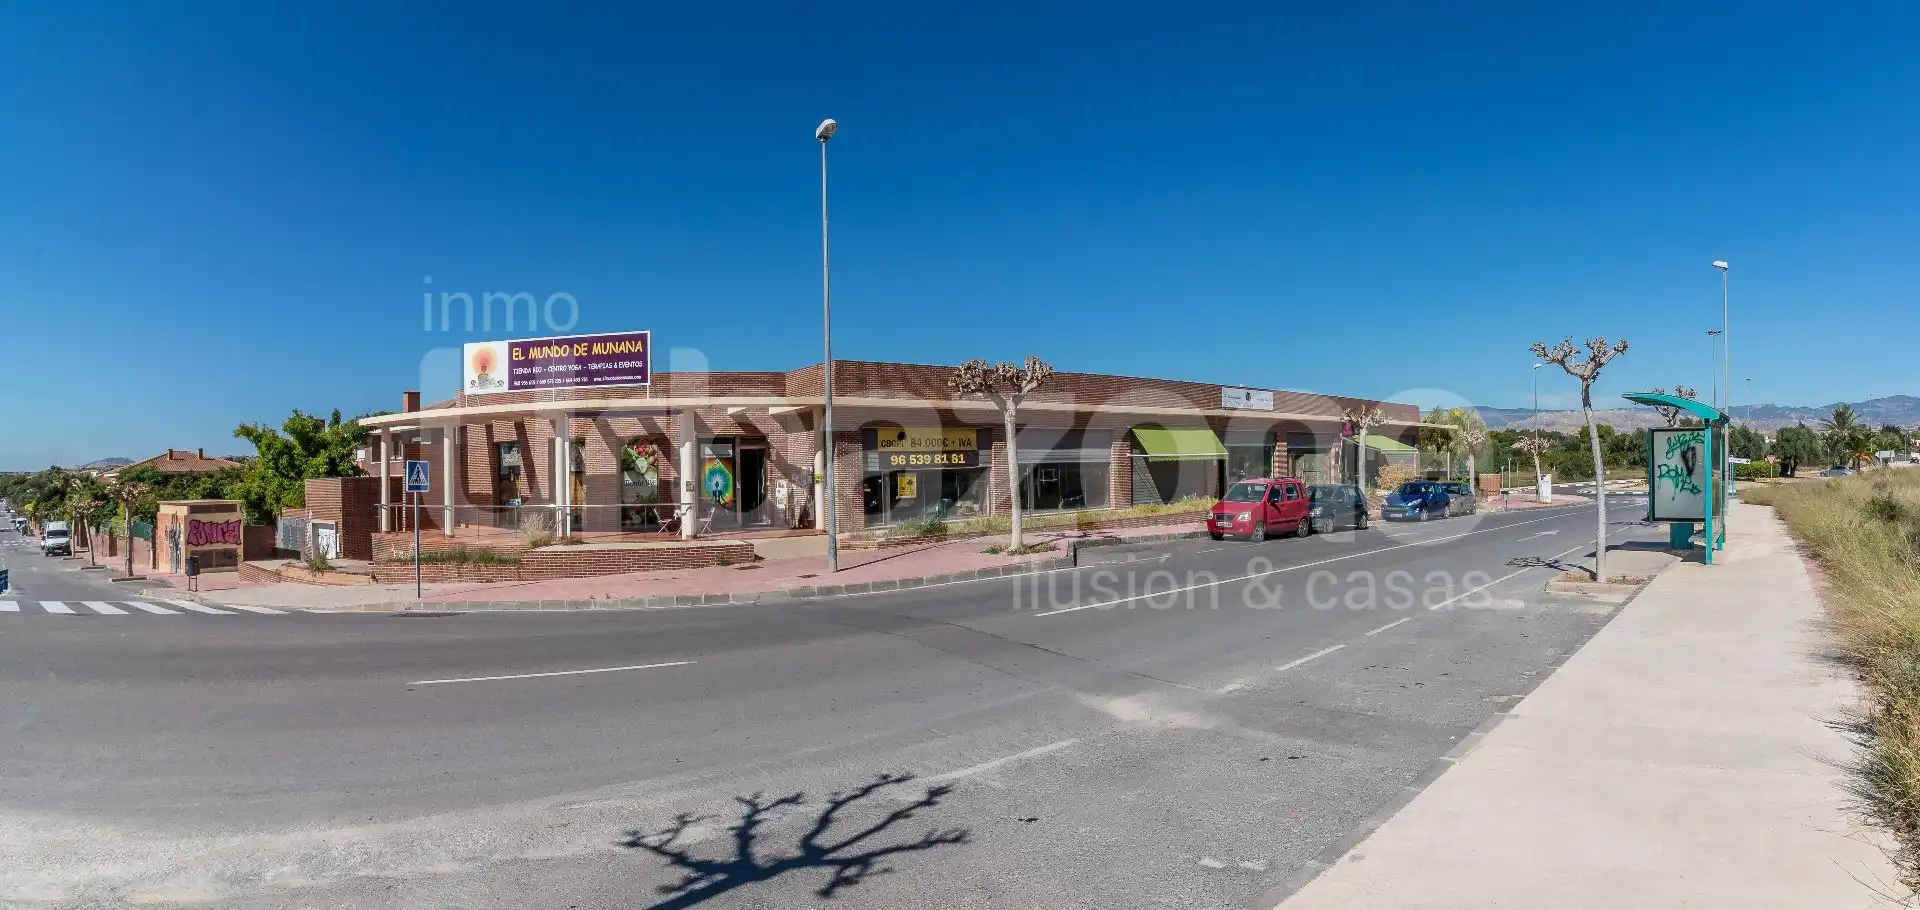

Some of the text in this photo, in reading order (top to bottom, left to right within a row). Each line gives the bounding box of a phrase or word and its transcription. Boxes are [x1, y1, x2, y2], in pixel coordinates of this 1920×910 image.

[512, 340, 643, 361] EL MUNDO DE MUNANA
[547, 364, 567, 373] CENTRO
[567, 364, 582, 372] YOGA
[618, 361, 643, 369] EVENTOS
[910, 437, 949, 448] 84.000€
[951, 439, 957, 447] +
[958, 437, 972, 447] IVA
[890, 453, 966, 465] 96 539 81 81
